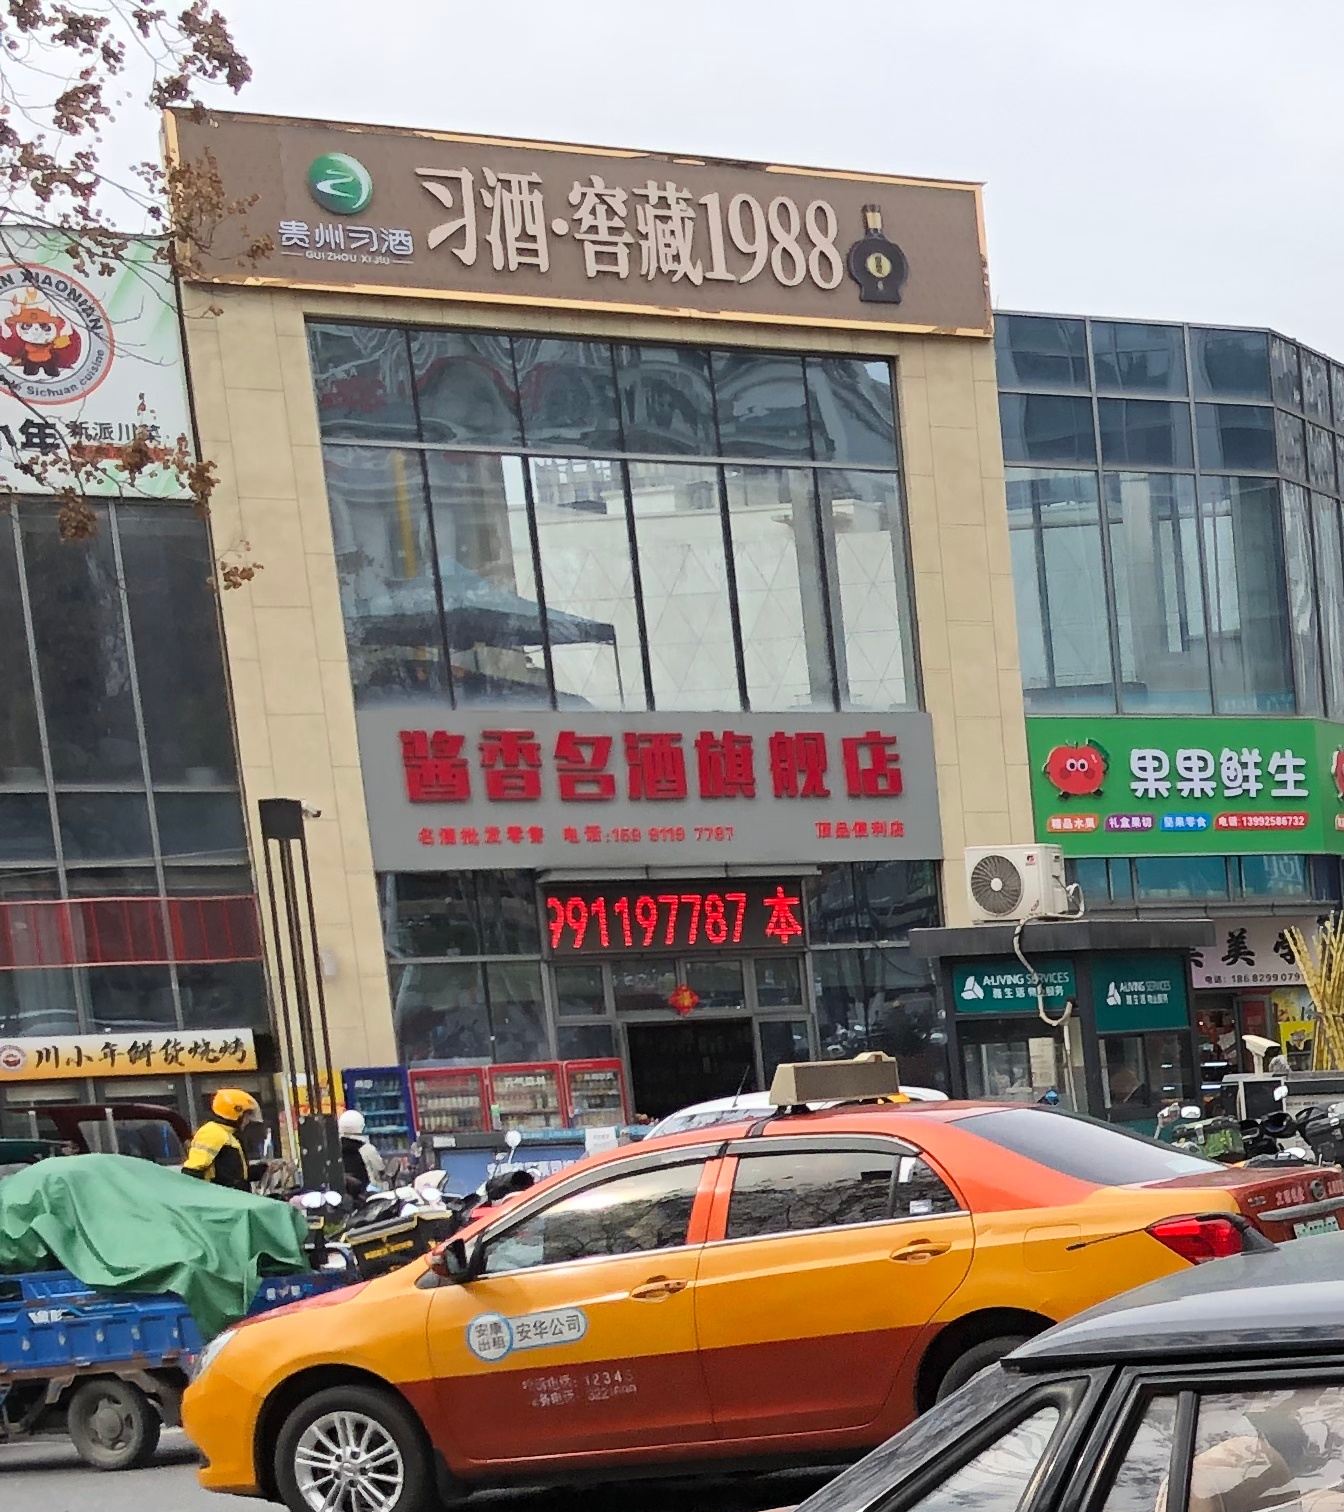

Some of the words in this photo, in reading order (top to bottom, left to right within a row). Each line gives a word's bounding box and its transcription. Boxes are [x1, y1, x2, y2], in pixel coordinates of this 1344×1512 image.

[277, 219, 414, 257] 贵州习酒
[415, 166, 844, 291] 习酒·窖藏1988
[398, 728, 904, 803] 酱香名酒旗舰店
[1128, 747, 1310, 800] 果果鲜生
[1252, 972, 1279, 983] 8299
[1281, 970, 1304, 982] 079
[474, 1321, 503, 1338] 安康
[478, 1337, 507, 1352] 出租
[515, 1314, 581, 1342] 安华公司
